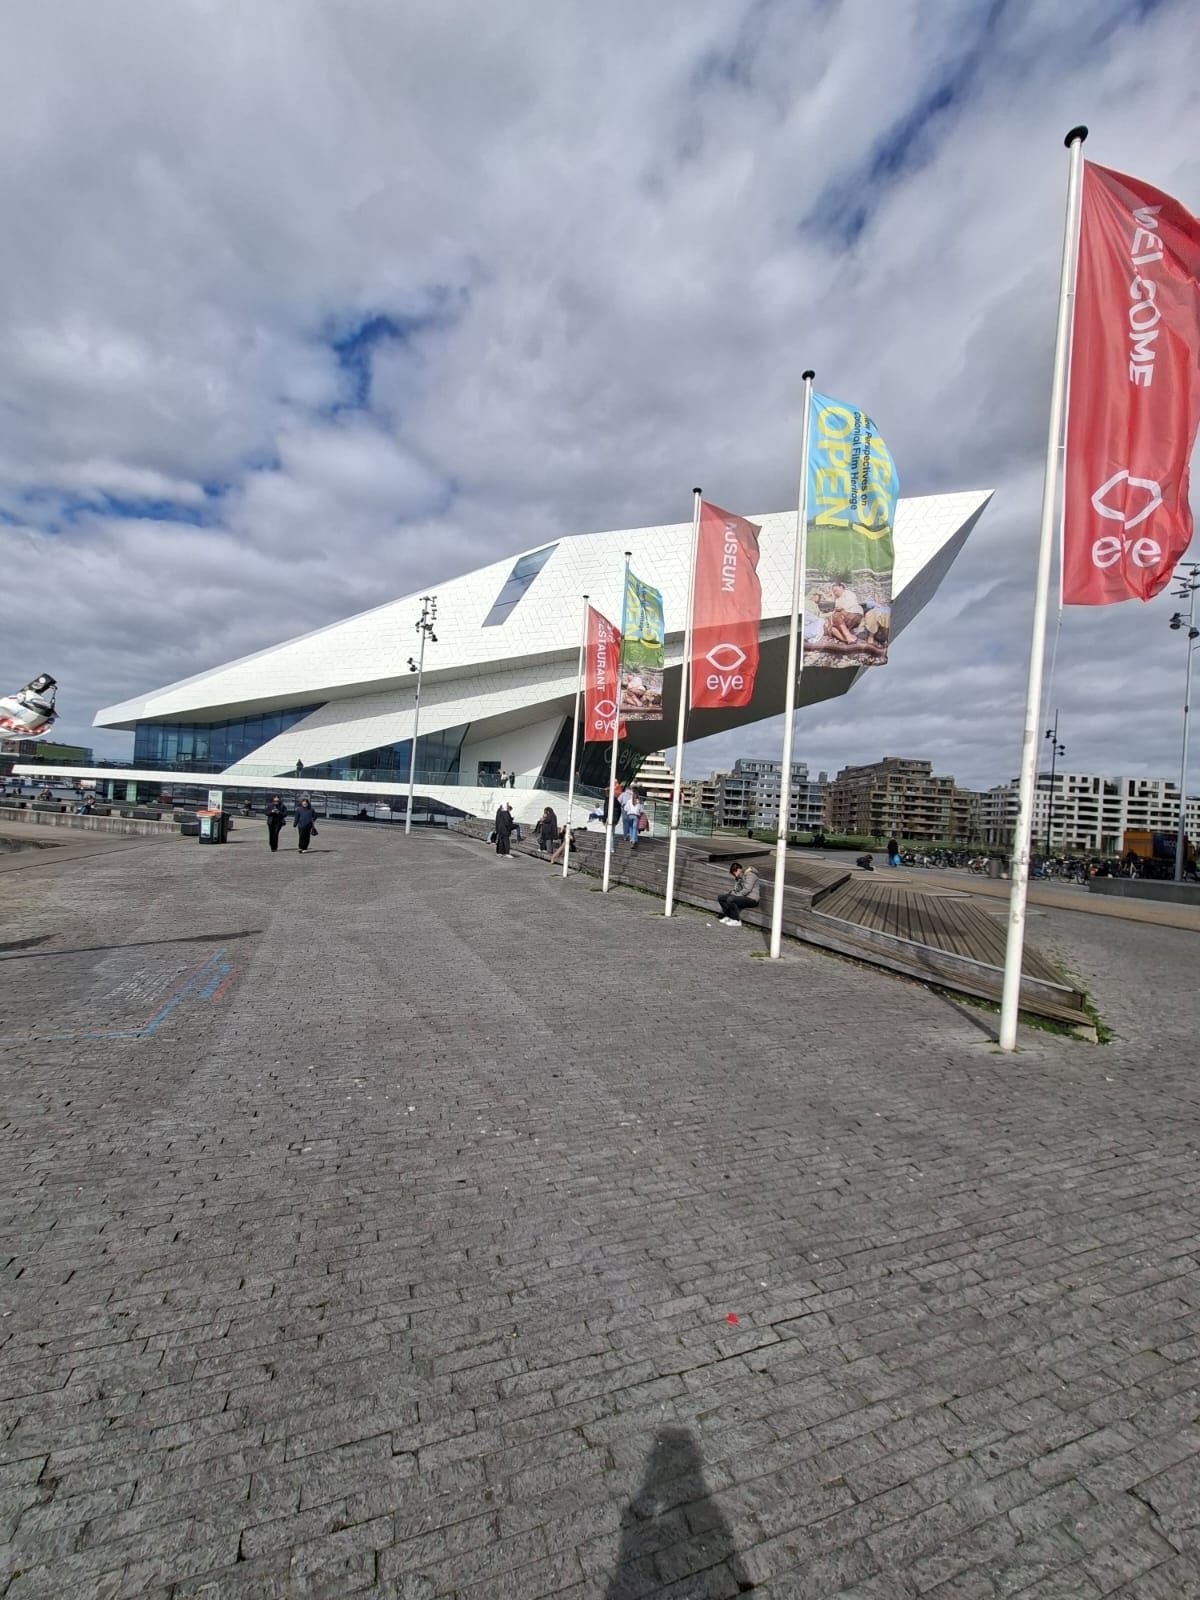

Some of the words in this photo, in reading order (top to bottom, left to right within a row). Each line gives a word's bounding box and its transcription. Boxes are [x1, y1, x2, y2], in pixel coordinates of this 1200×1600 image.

[1128, 205, 1163, 388] WELCOME
[852, 411, 862, 446] Colonial
[815, 406, 855, 527] OPEN
[851, 448, 862, 470] Film
[852, 411, 892, 540] YE(S)
[849, 471, 860, 511] Heritage
[860, 494, 868, 506] on
[596, 620, 607, 692] ESTAURANT
[706, 674, 744, 697] eye
[594, 719, 618, 734] eye
